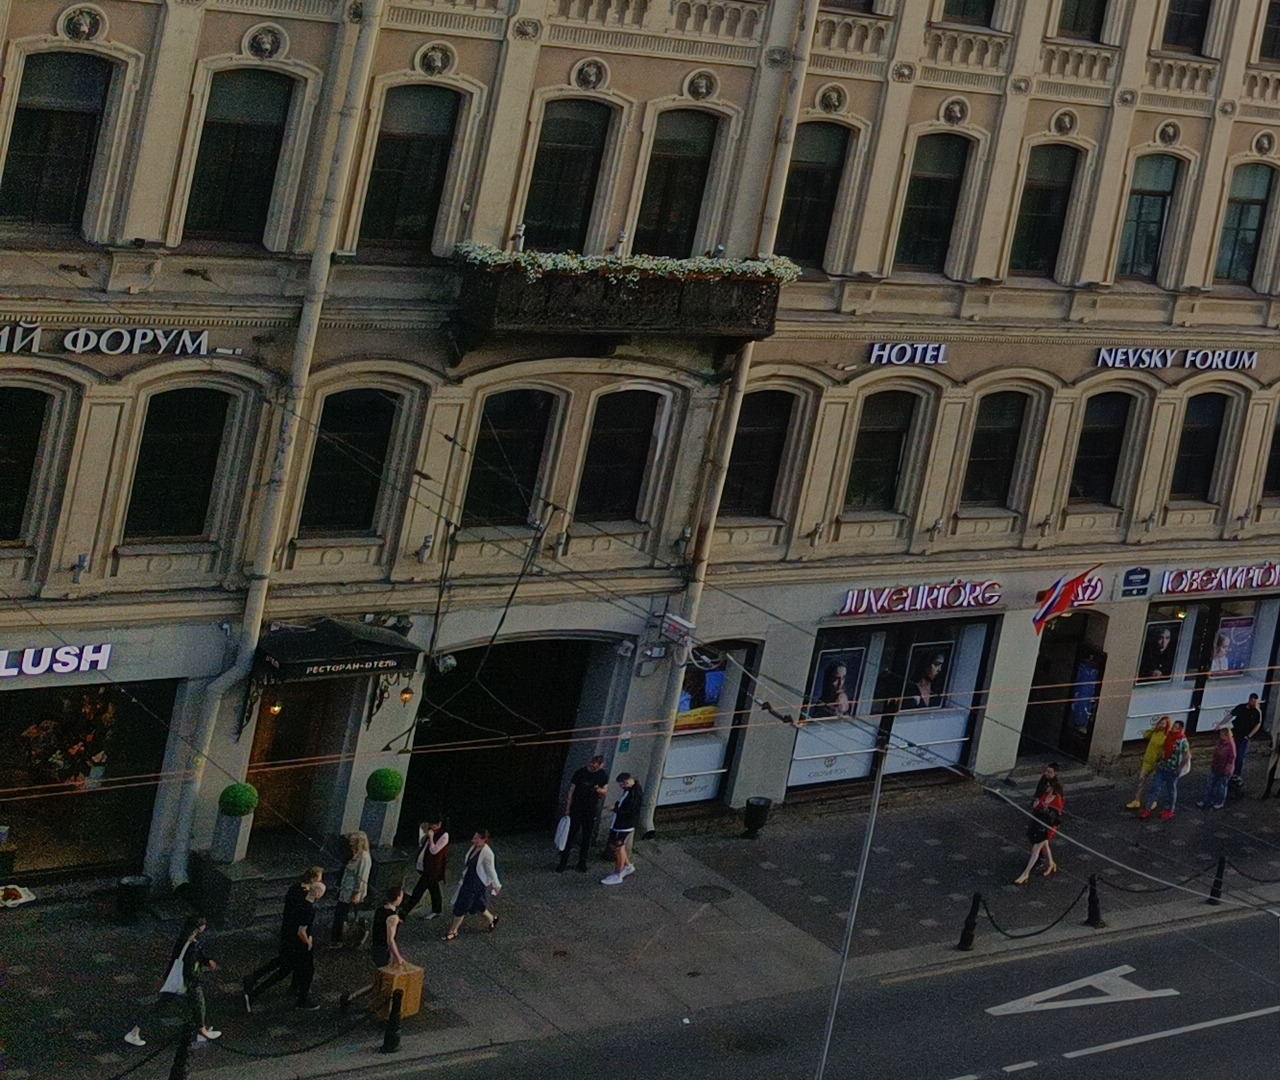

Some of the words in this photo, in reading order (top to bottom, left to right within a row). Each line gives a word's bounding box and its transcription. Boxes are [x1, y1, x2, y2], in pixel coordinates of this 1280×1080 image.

[63, 327, 210, 356] ФОРУМ
[869, 343, 949, 365] HOTEL
[1097, 347, 1177, 369] NEVSKY
[1184, 349, 1259, 370] FORUM
[0, 643, 113, 677] LUSH
